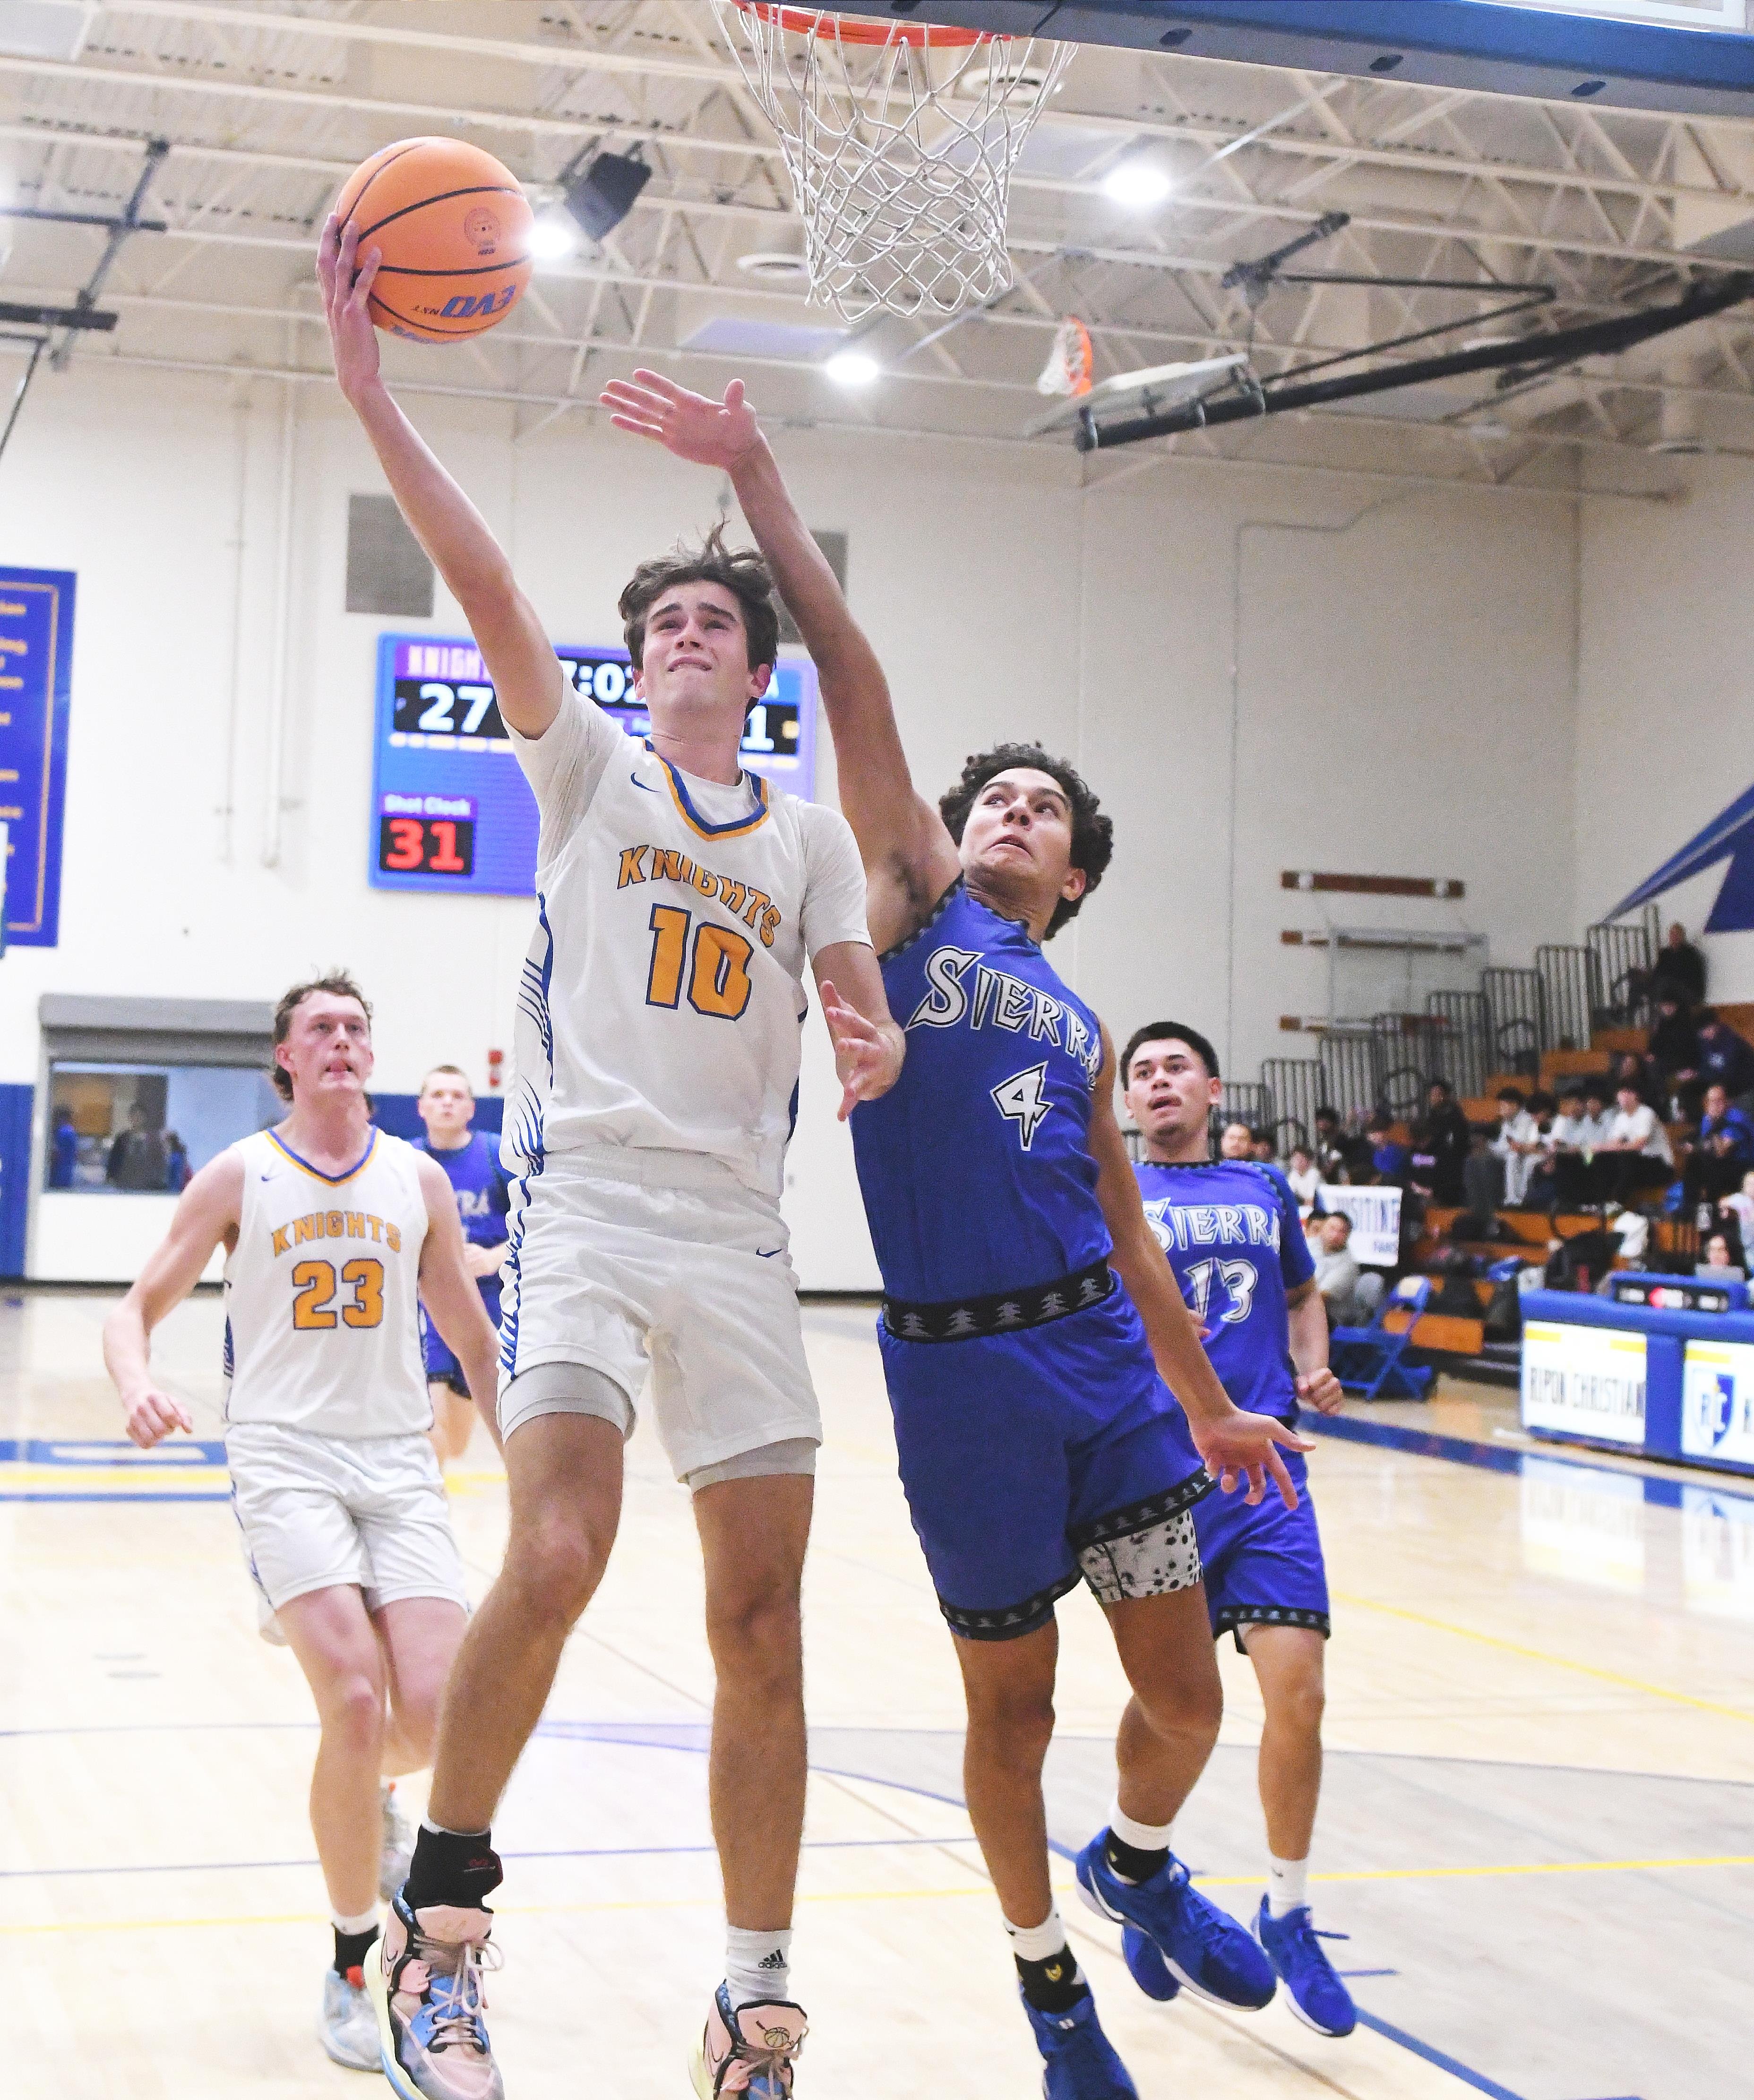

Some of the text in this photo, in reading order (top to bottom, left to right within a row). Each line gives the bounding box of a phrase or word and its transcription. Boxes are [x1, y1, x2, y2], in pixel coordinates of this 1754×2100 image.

[418, 682, 494, 733] 27
[386, 818, 464, 871] 31
[617, 844, 782, 948] KNIGHTS
[645, 903, 755, 1021] 10
[989, 1060, 1055, 1152] 4
[272, 1210, 402, 1257] KNIGHTS
[292, 1258, 385, 1330] 23
[1183, 1257, 1259, 1324] 13
[1530, 1366, 1566, 1406] RIPON
